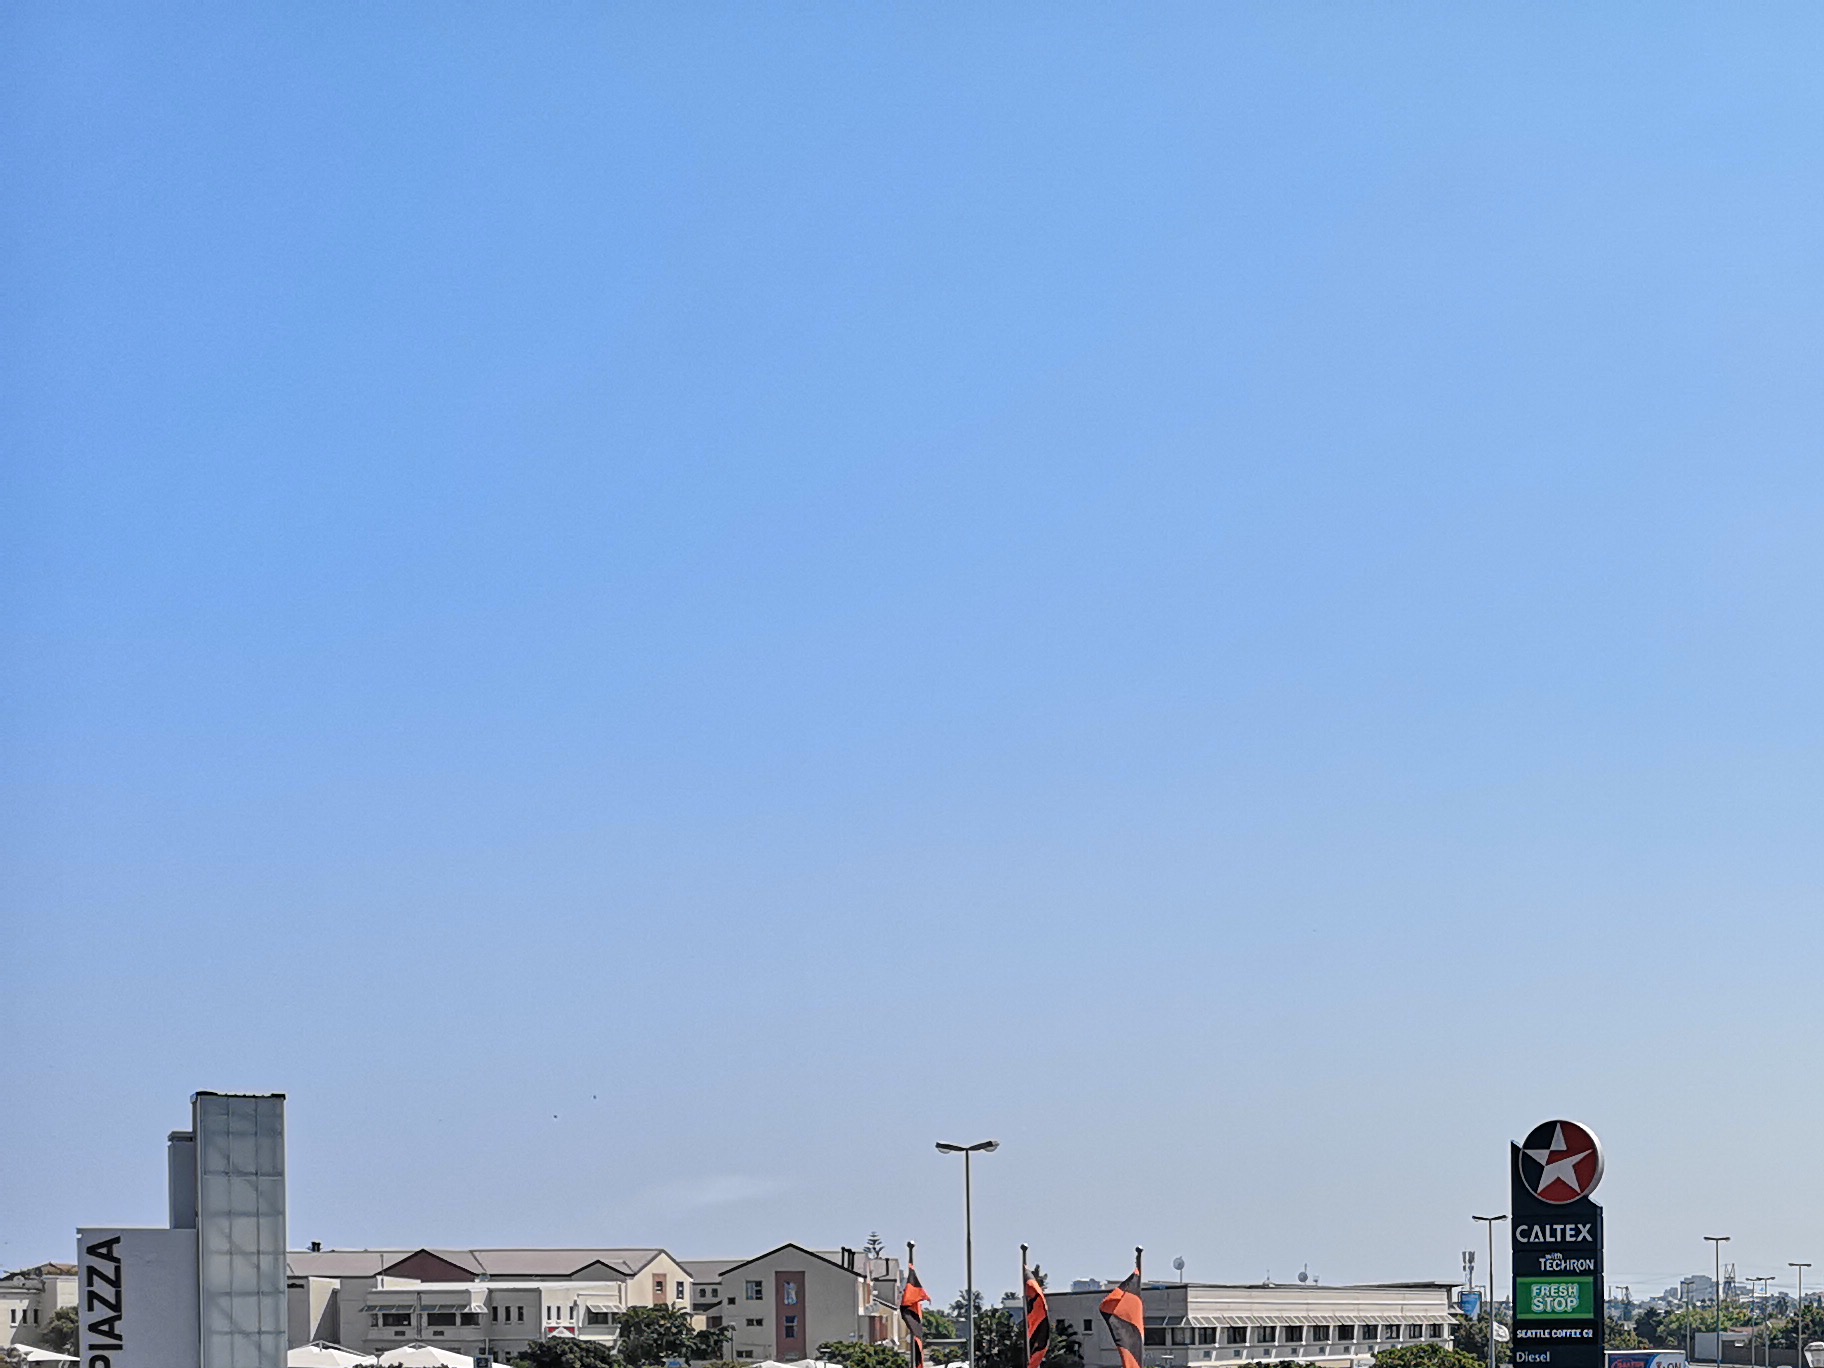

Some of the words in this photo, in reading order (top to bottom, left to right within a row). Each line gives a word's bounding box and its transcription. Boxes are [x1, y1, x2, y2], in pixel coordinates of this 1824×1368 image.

[1515, 1224, 1593, 1242] CALTEX
[1539, 1258, 1594, 1273] TECHRON
[1532, 1284, 1579, 1297] FRESH
[1532, 1297, 1579, 1312] STOP
[1516, 1329, 1550, 1338] SEATTLE
[1552, 1329, 1581, 1338] COFFEE
[1516, 1351, 1550, 1362] Diesel
